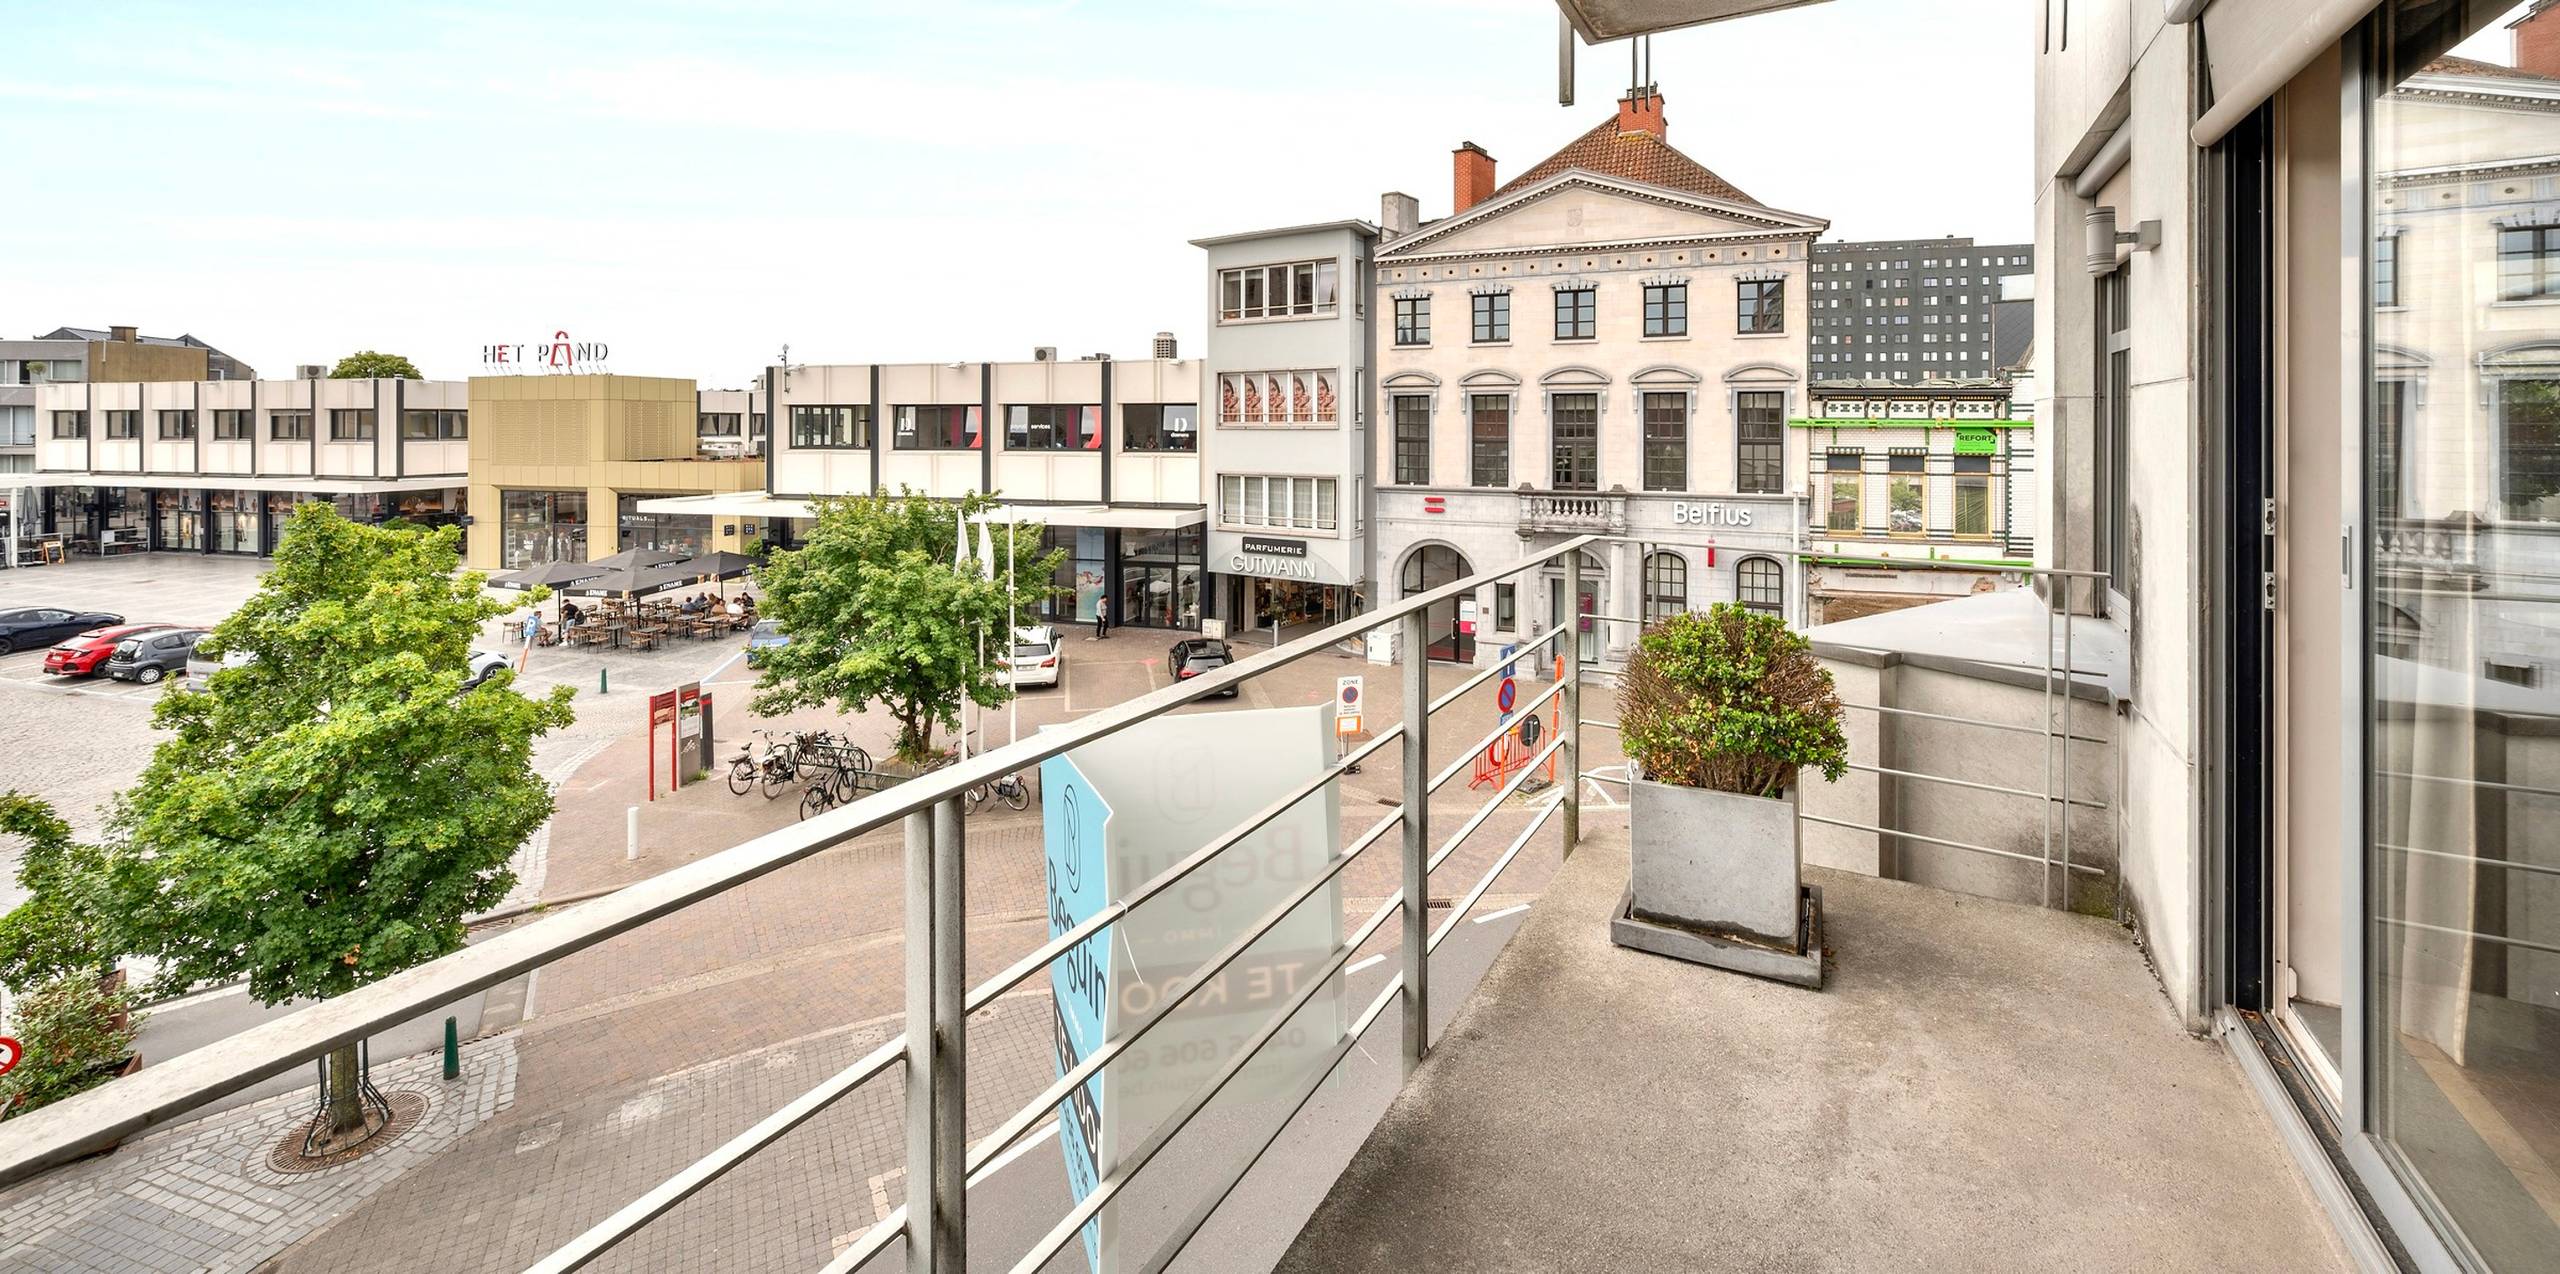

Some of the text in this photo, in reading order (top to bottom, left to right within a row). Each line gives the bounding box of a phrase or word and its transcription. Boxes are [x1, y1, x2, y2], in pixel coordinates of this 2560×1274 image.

[483, 344, 525, 363] HET
[1960, 434, 1993, 442] REFORT
[1673, 502, 1752, 526] Belfius
[1245, 543, 1303, 555] PARFUMERIE
[1231, 554, 1316, 578] GUTMANN
[662, 580, 683, 591] ENAME
